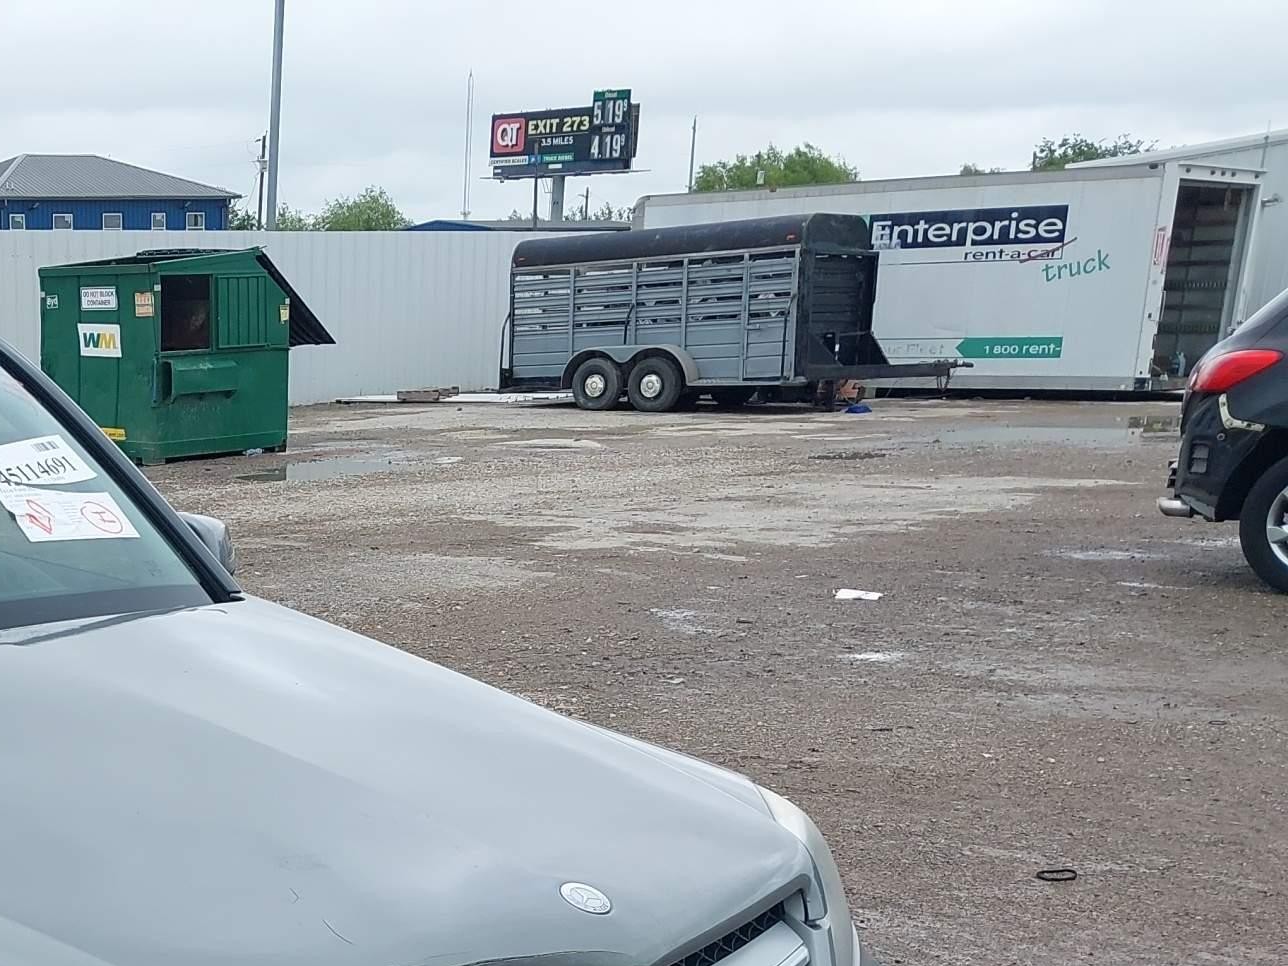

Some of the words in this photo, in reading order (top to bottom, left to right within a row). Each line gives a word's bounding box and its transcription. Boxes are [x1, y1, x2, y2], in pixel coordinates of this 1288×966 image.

[528, 120, 560, 135] EXIT
[563, 116, 590, 132] 273
[497, 123, 520, 147] QT
[541, 138, 552, 146] 3.5
[553, 136, 574, 145] MILES
[871, 211, 1063, 247] Enterprise
[964, 247, 1062, 261] rent-a-car
[1042, 250, 1111, 282] truck
[83, 332, 117, 349] WM
[993, 345, 1018, 354] 800
